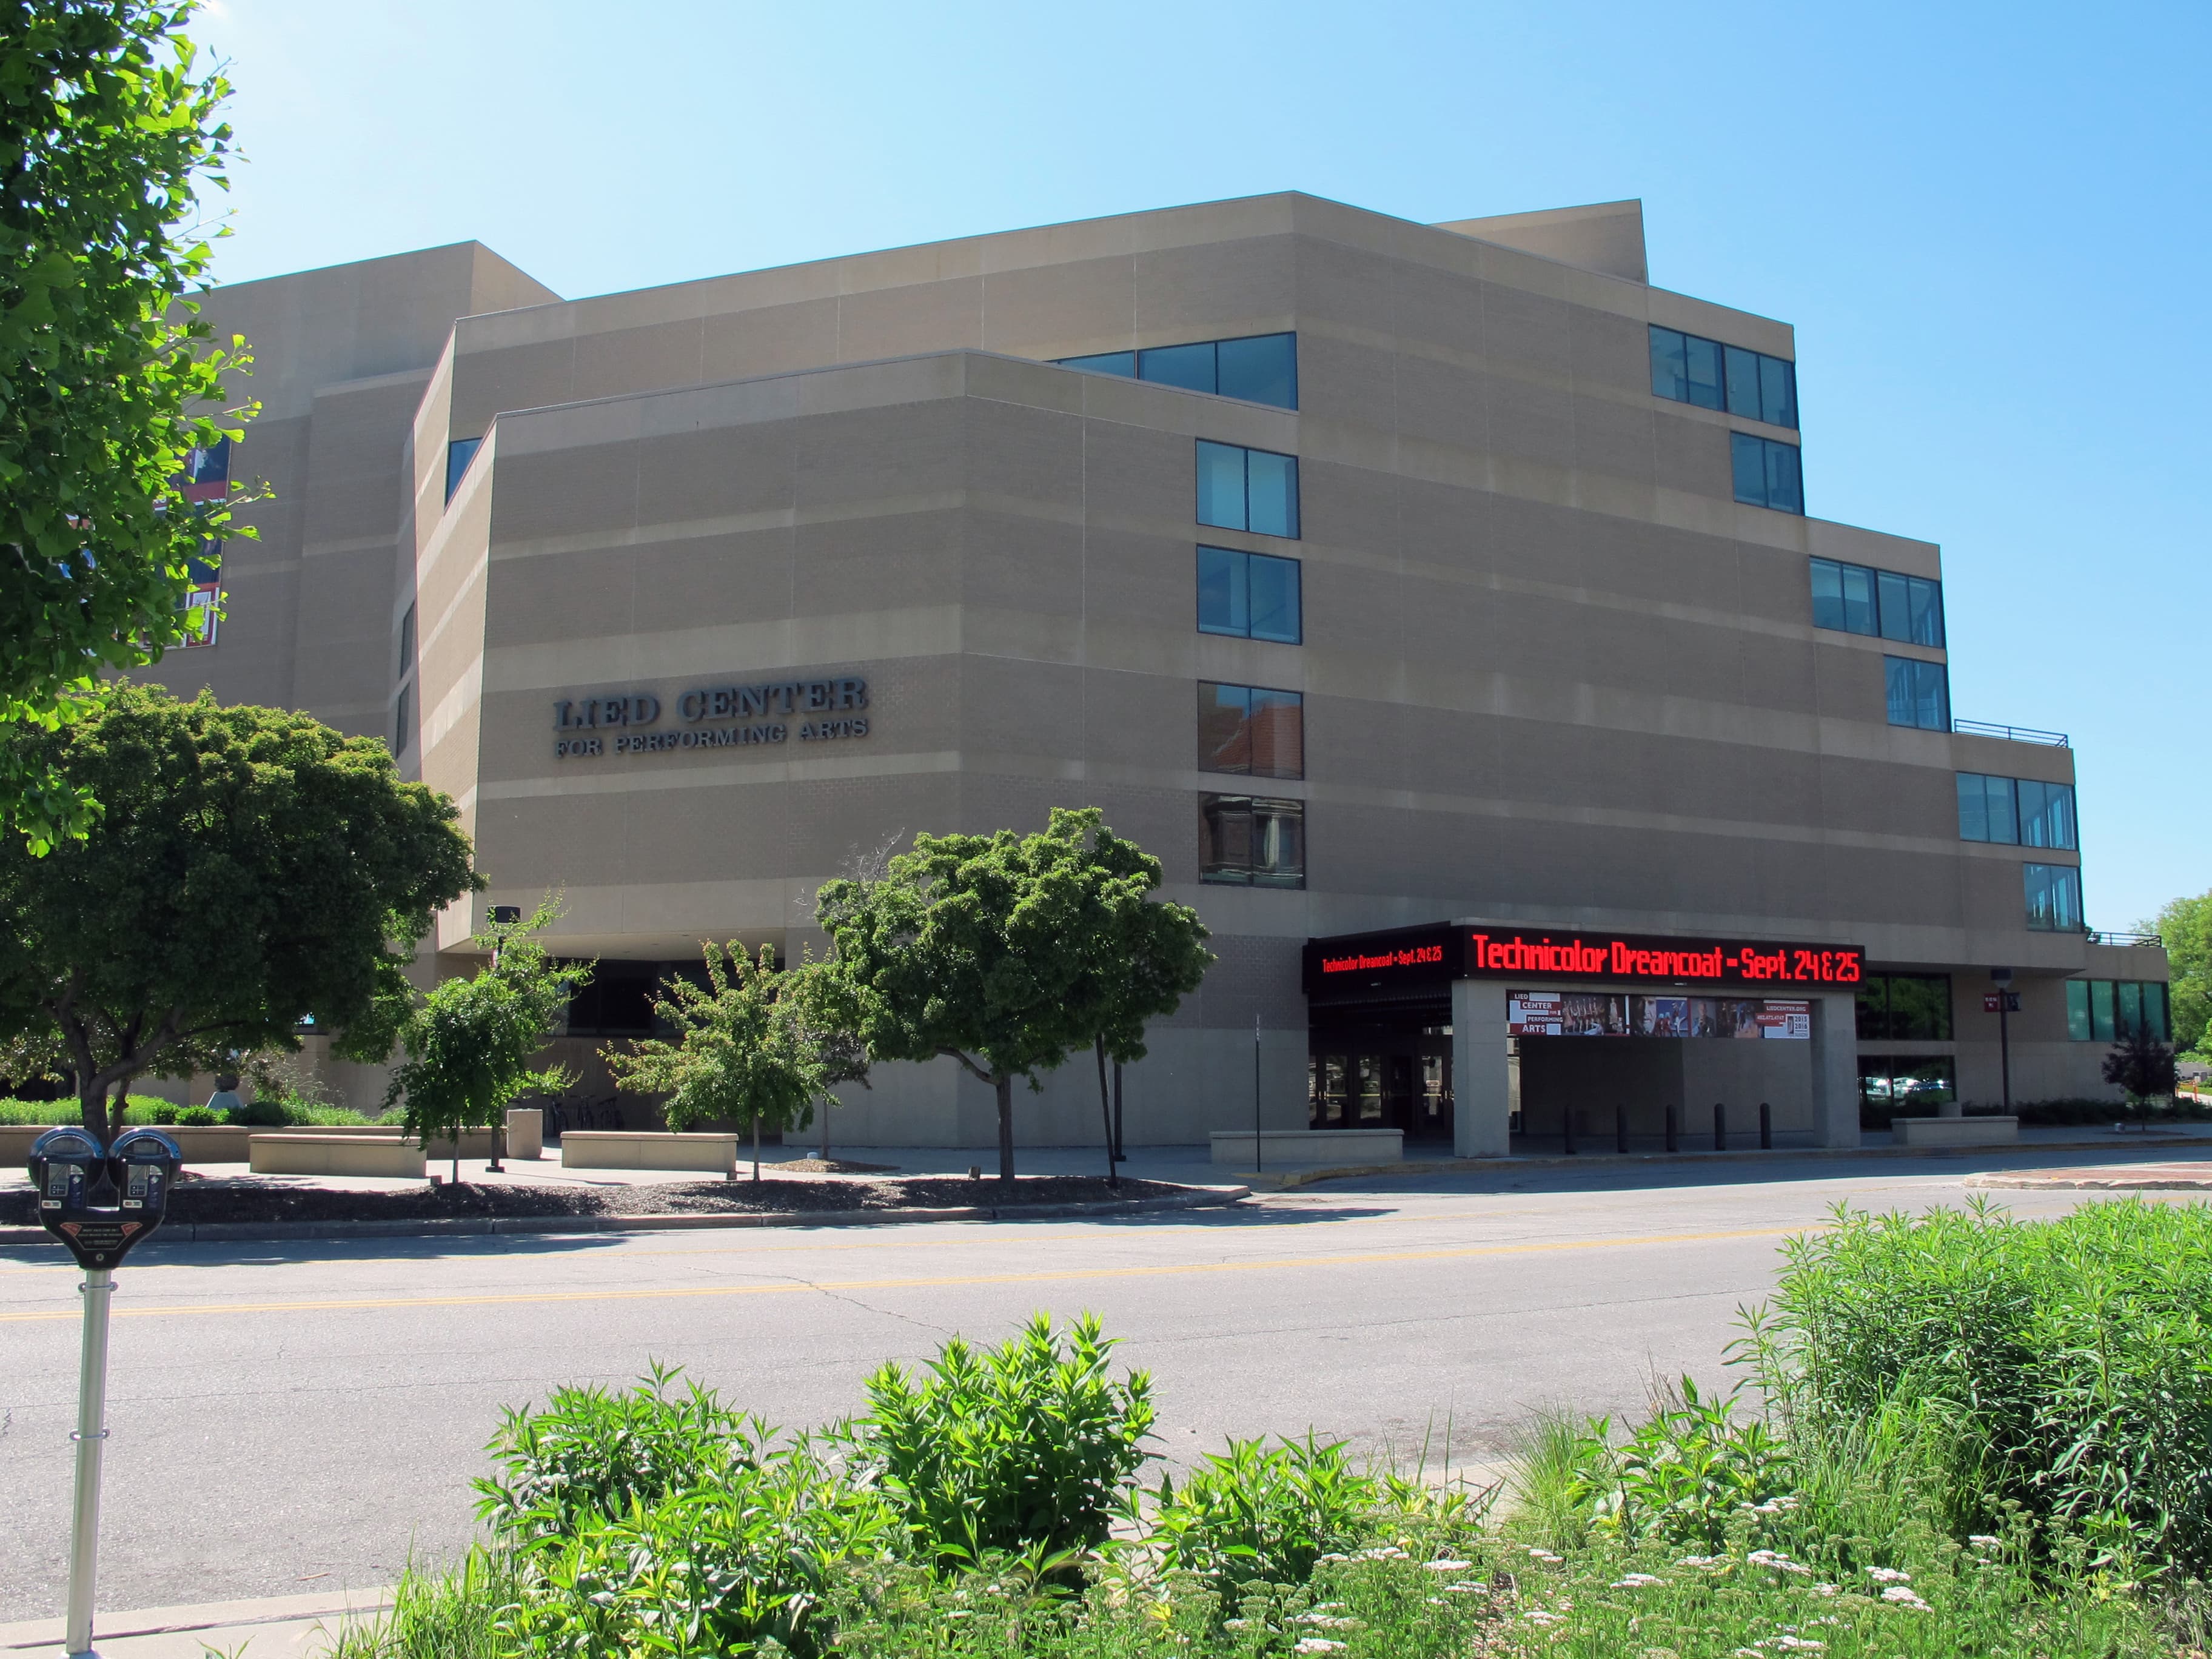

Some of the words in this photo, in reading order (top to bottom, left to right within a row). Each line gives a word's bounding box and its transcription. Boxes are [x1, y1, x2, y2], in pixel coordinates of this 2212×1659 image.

[553, 694, 660, 731] LIED
[677, 677, 869, 723] CENTER
[554, 737, 603, 758] FOR
[614, 723, 787, 756] PERFORMING
[799, 719, 868, 740] ARTS
[1322, 956, 1358, 973] Technicolor
[1398, 949, 1416, 965] Sept.
[1432, 945, 1441, 961] 25
[1473, 934, 1607, 973] Technicolor
[1611, 941, 1723, 977] Dreamcoat
[1741, 948, 1791, 980] Sept.
[1794, 950, 1818, 980] 24
[1835, 952, 1860, 982] 25
